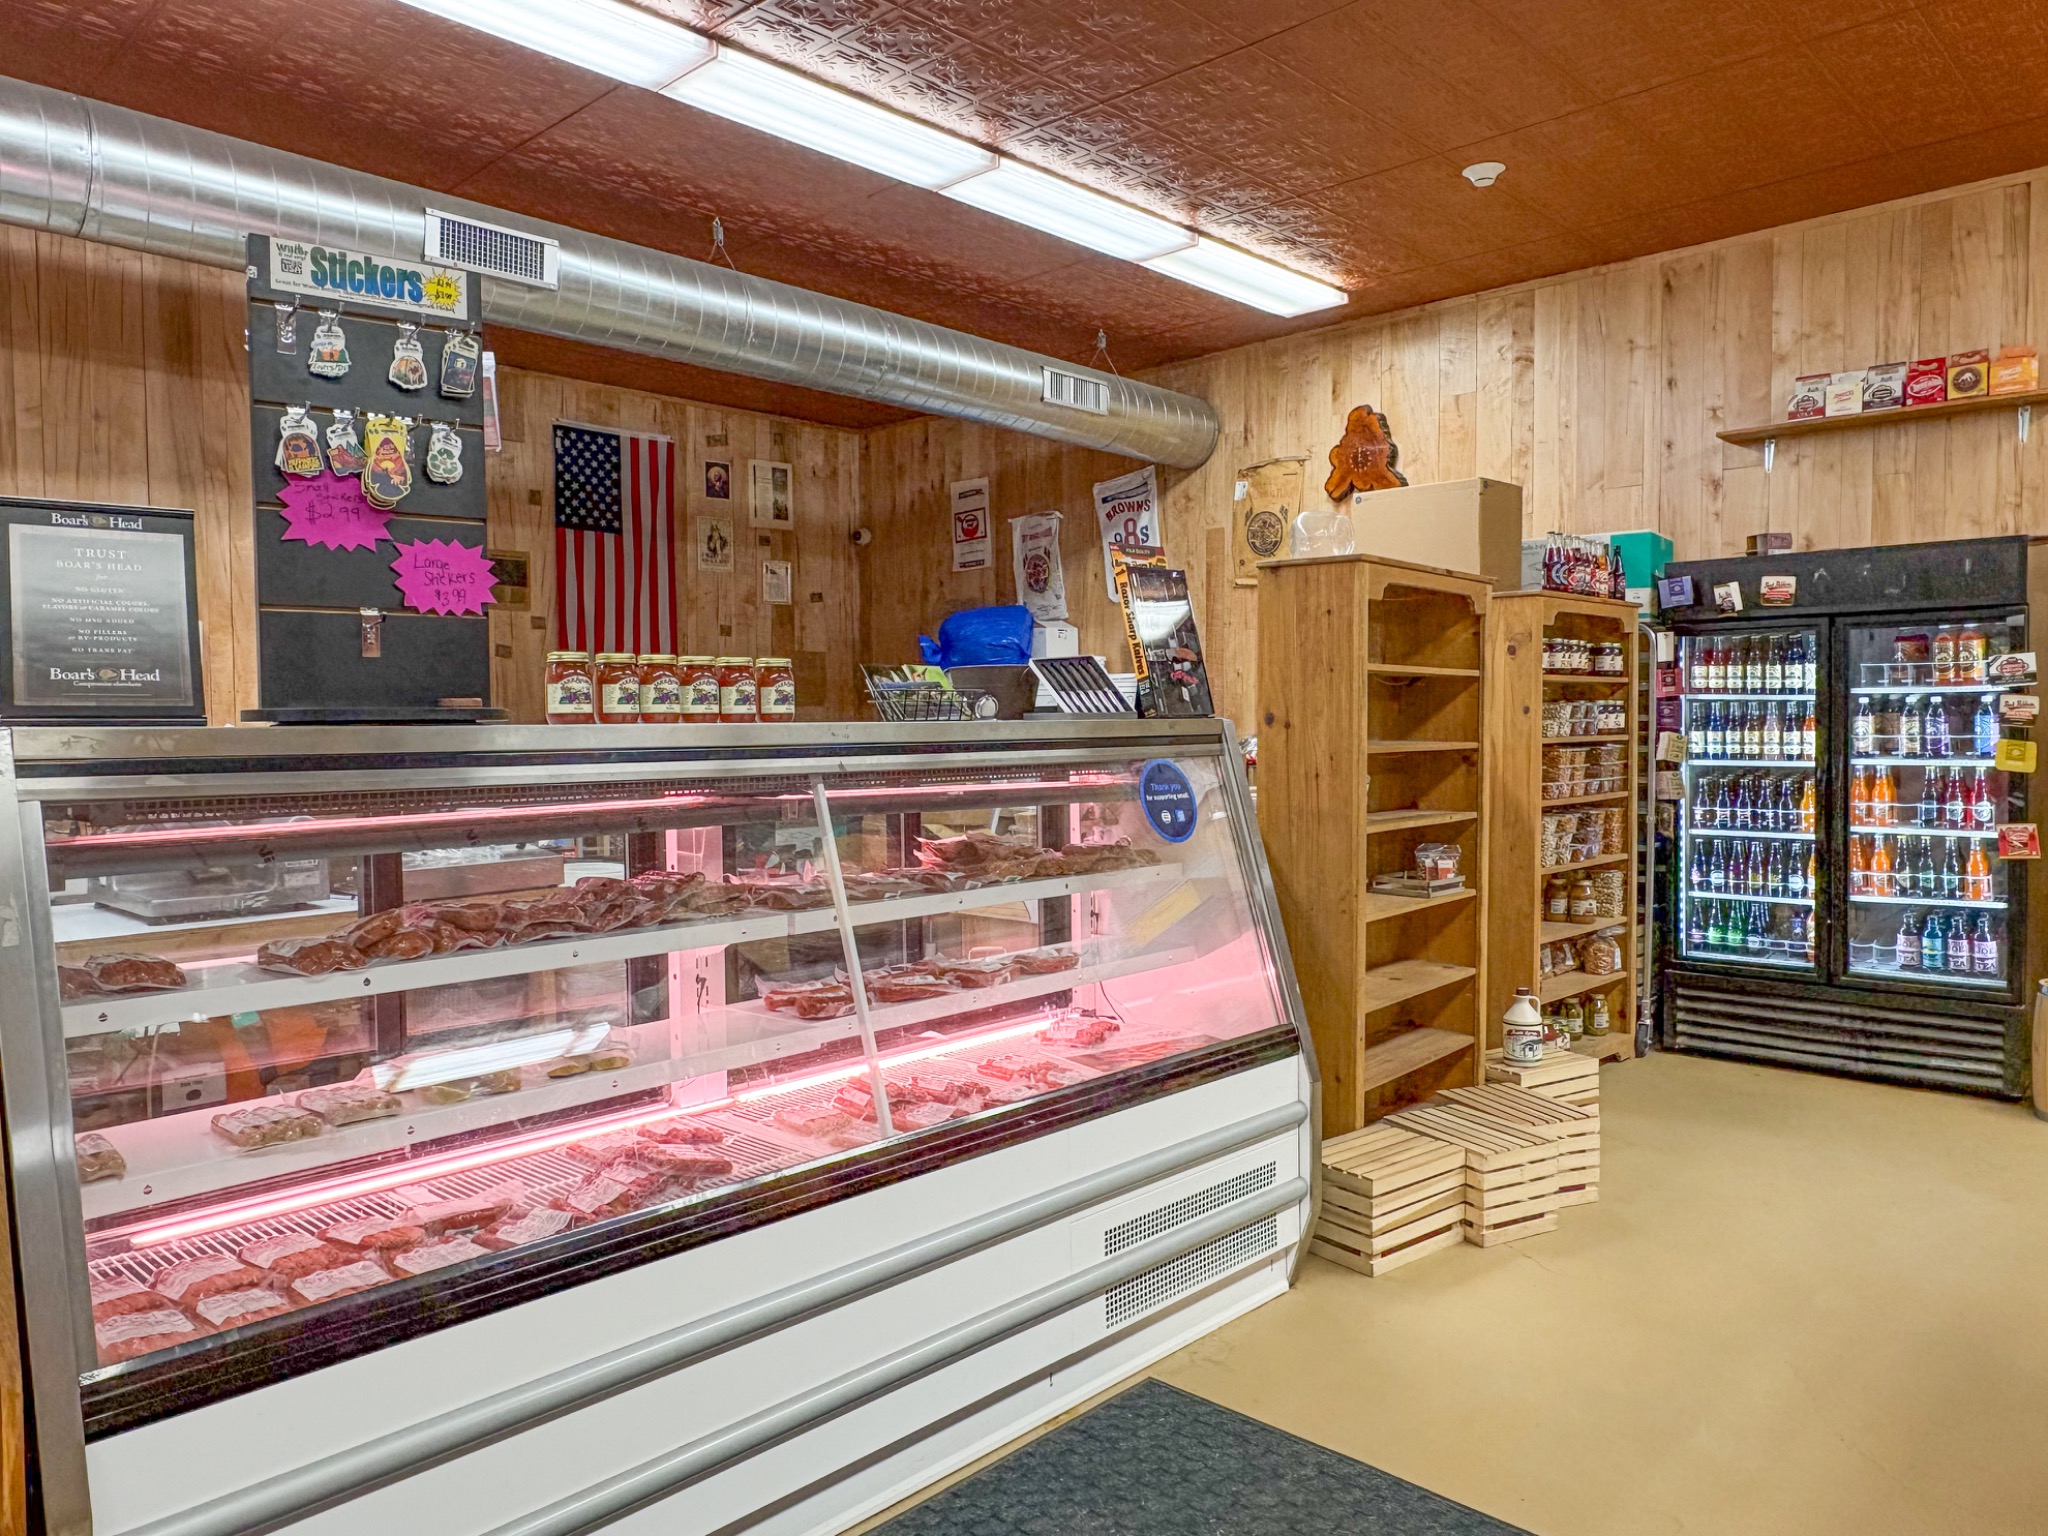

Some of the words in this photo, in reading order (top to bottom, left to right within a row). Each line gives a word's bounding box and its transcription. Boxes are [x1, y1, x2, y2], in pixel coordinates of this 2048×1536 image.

[310, 246, 424, 303] Stickers
[1105, 499, 1151, 522] BROWNS
[51, 512, 89, 526] Boar's
[109, 516, 143, 530] Head
[74, 547, 127, 559] TRUST
[56, 560, 102, 570] BOAR'S
[107, 562, 142, 571] HEAD
[413, 553, 450, 577] Large
[423, 571, 476, 586] Stickers
[50, 667, 96, 681] Boar's
[120, 668, 161, 682] Head
[1150, 783, 1170, 791] Thank
[1170, 783, 1181, 792] you
